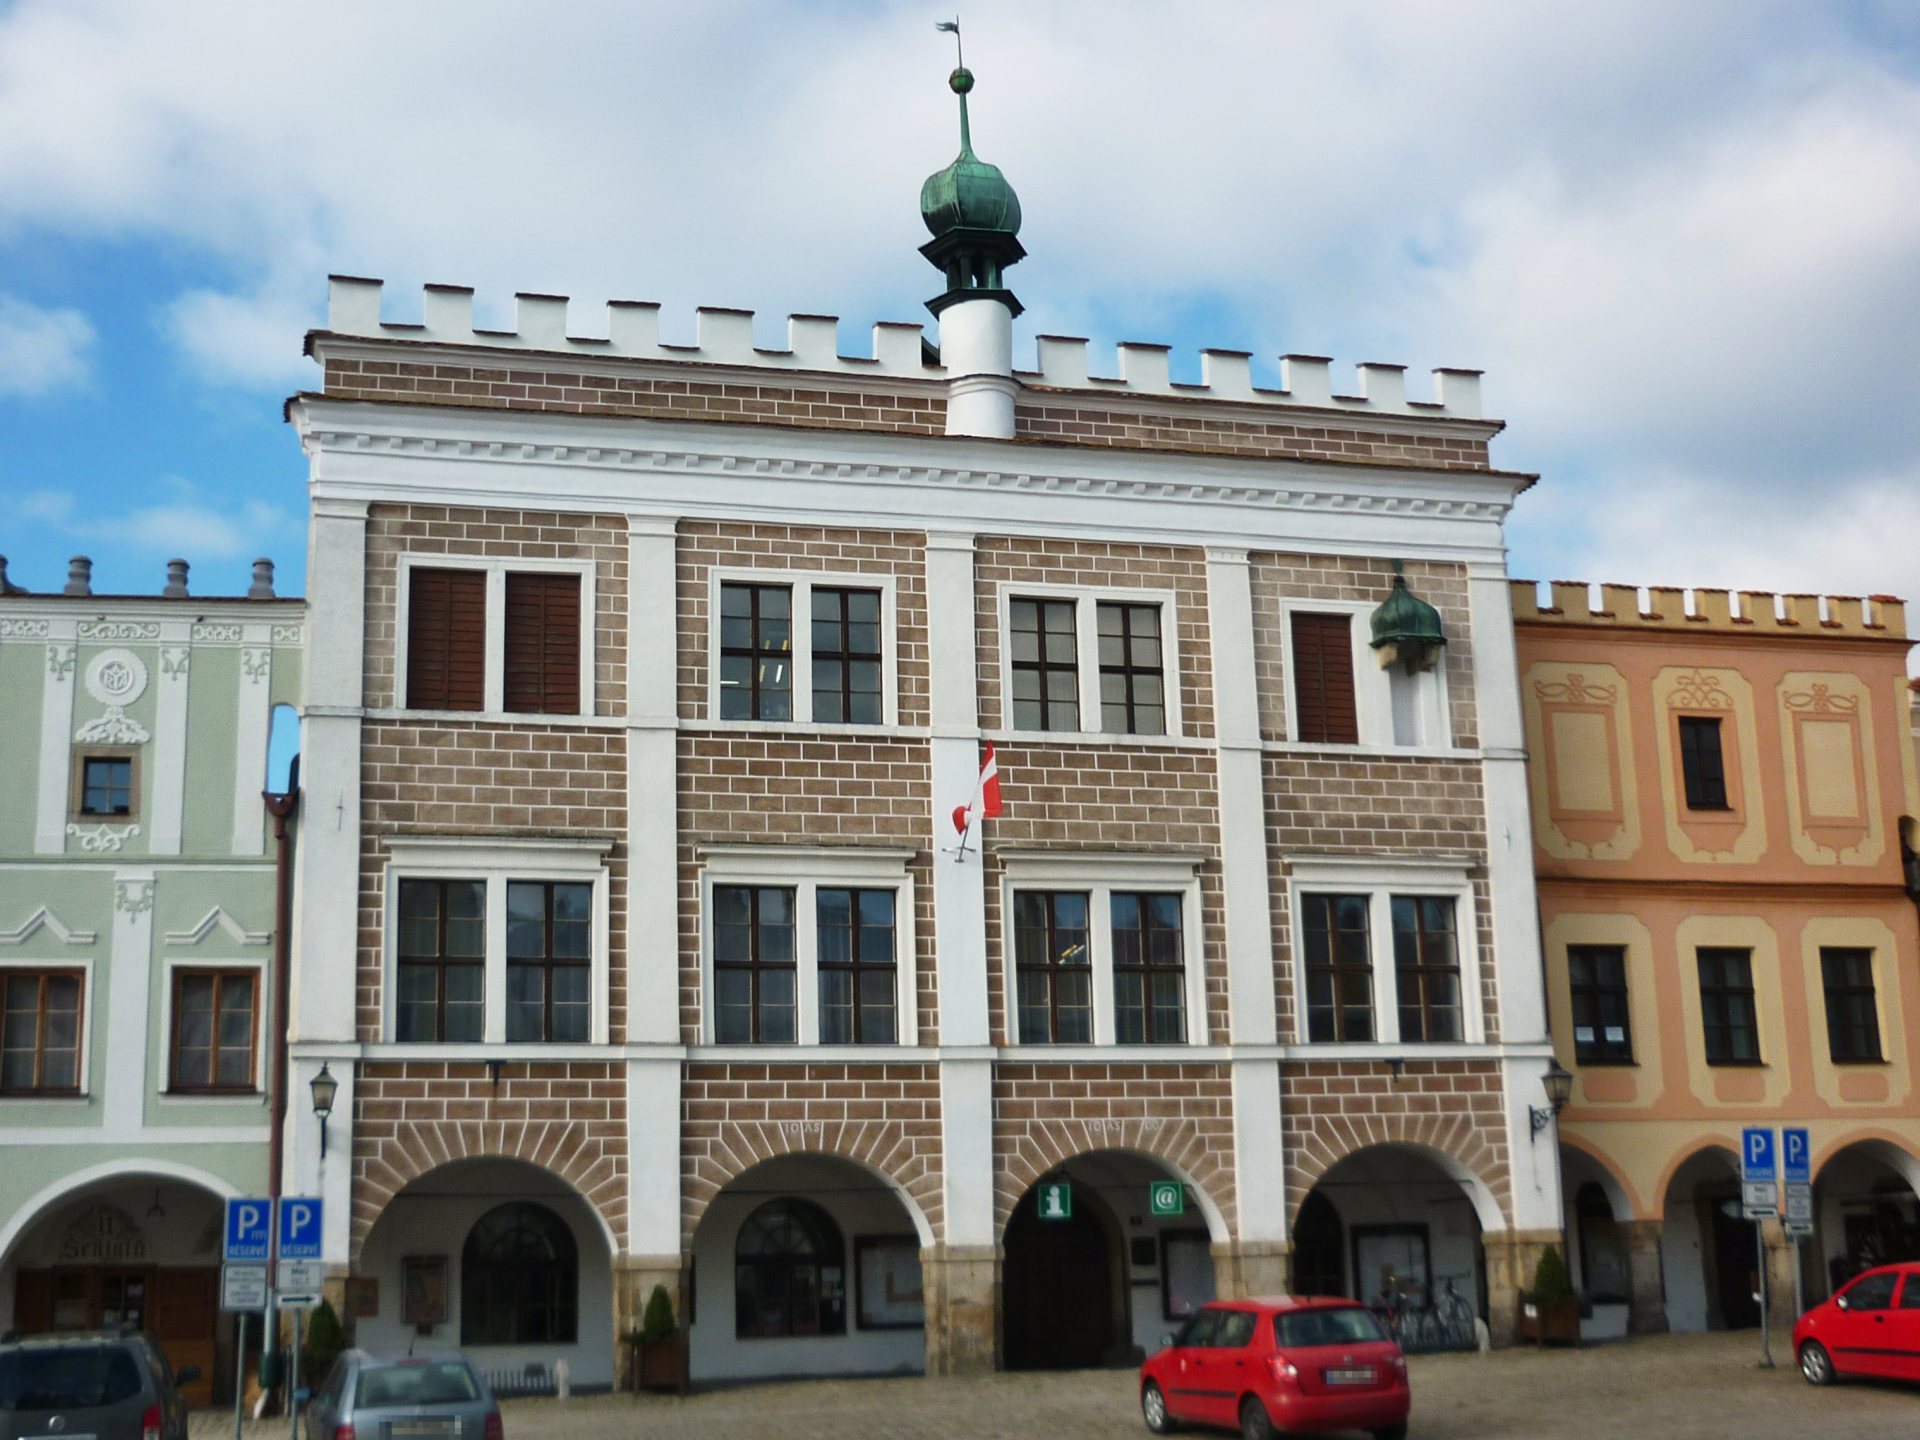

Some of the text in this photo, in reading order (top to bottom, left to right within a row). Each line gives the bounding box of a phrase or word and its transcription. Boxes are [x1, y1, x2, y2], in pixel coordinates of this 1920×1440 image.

[1750, 1133, 1766, 1163] P
[1788, 1134, 1802, 1163] P
[238, 1204, 260, 1239] P
[291, 1204, 312, 1238] P
